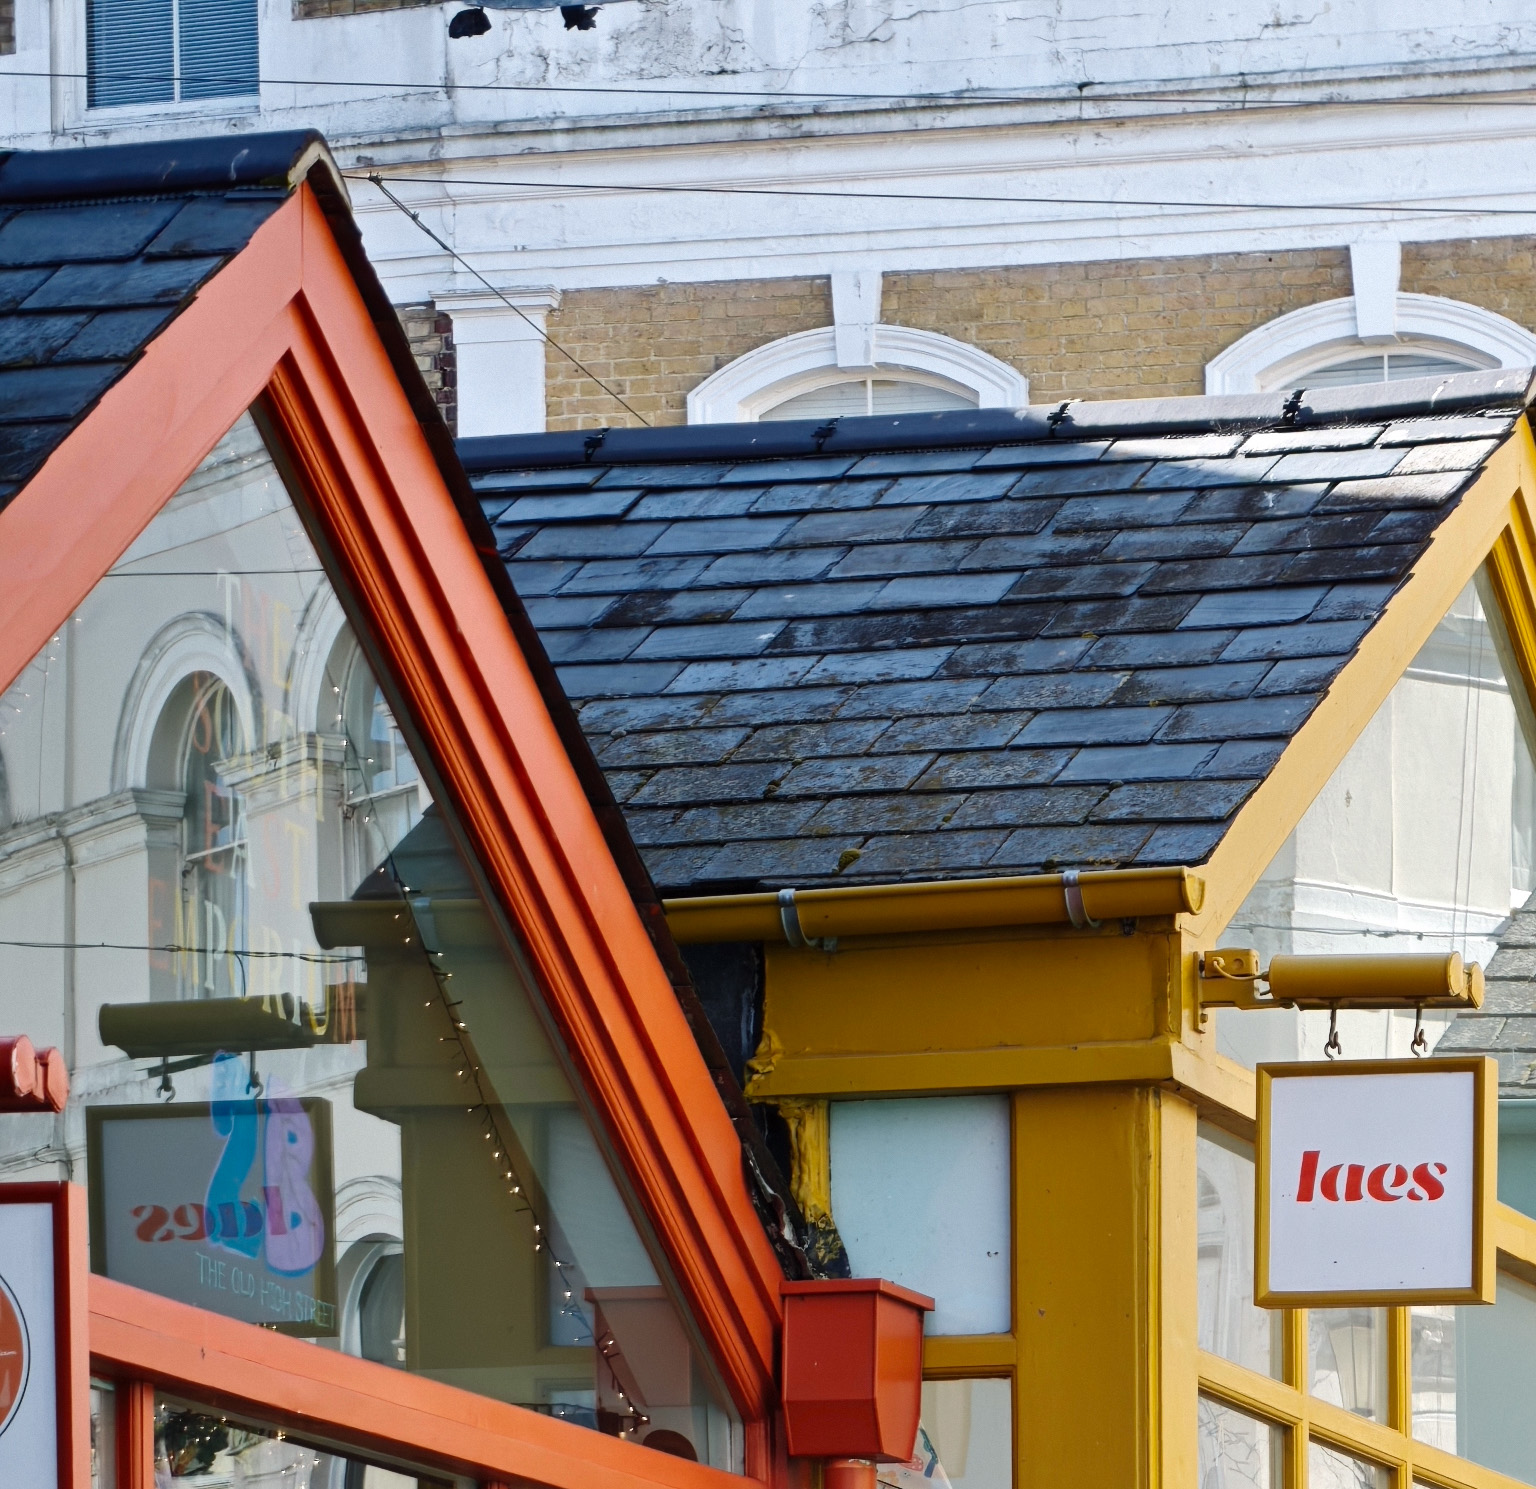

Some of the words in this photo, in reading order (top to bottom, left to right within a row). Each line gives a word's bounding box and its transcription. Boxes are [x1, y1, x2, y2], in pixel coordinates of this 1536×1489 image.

[148, 875, 358, 1050] EMPORIUM
[1296, 1151, 1447, 1204] laes
[197, 1251, 227, 1291] THE
[230, 1265, 256, 1299] OLD
